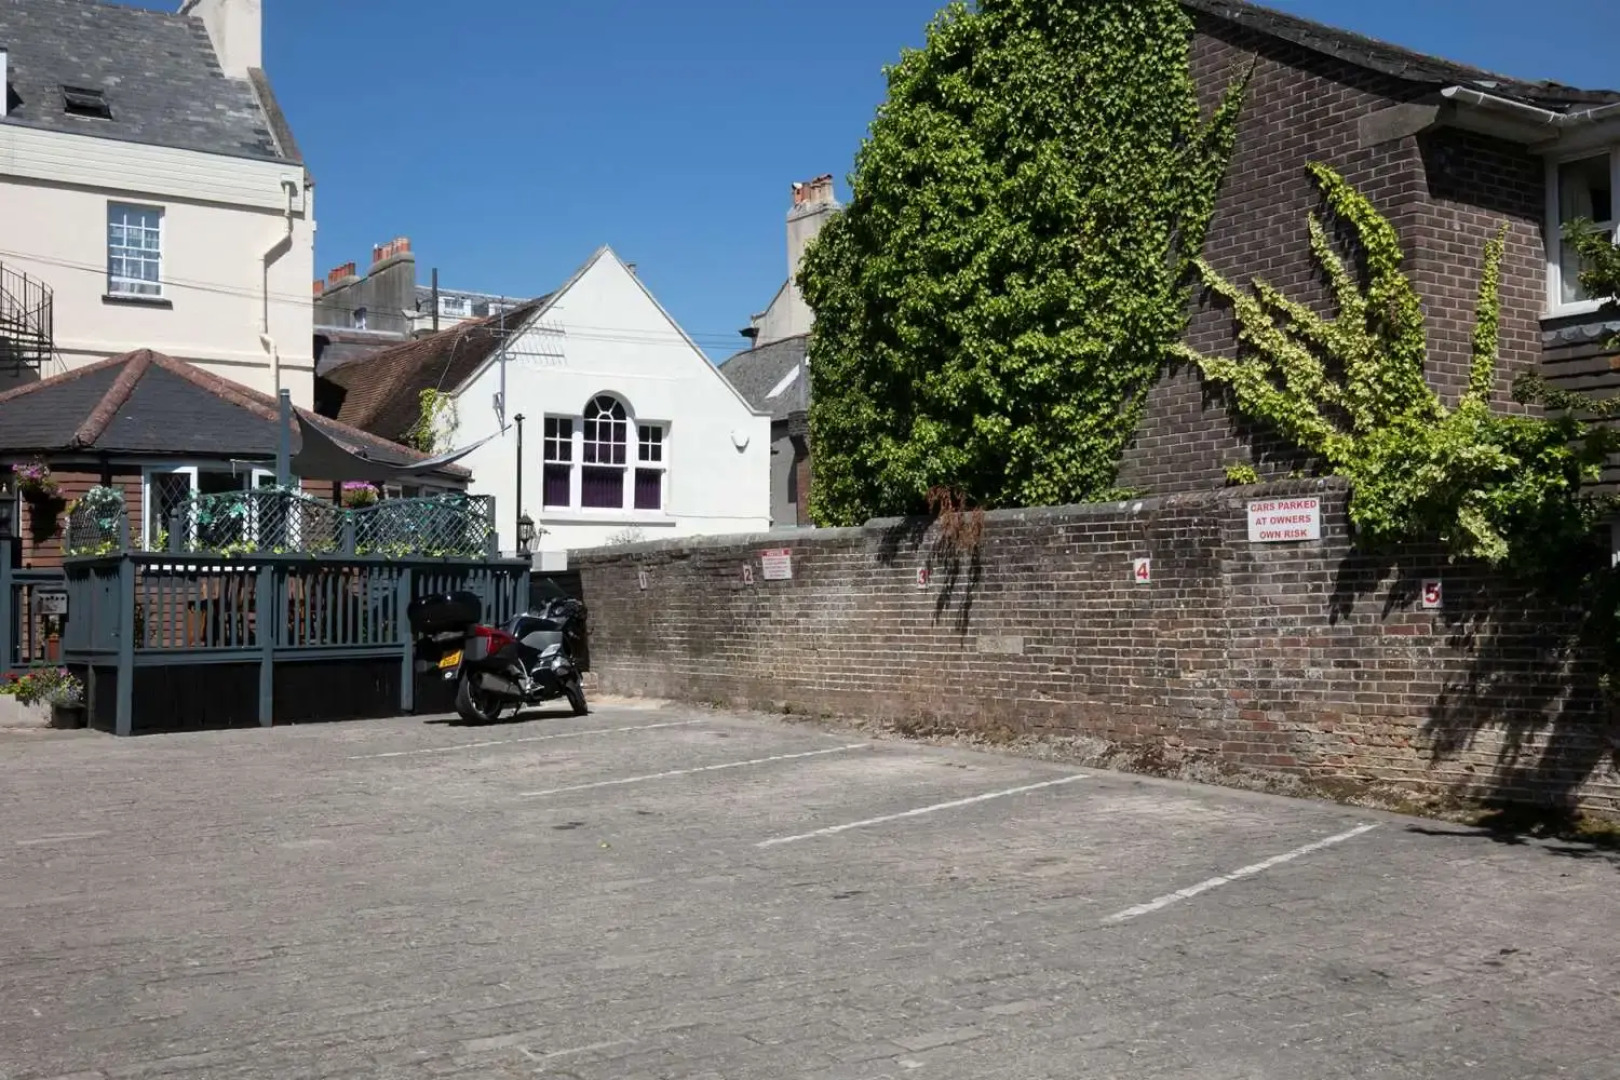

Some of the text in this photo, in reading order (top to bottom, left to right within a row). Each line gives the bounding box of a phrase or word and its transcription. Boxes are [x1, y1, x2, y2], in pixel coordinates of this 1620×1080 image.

[1250, 500, 1317, 512] CARS PARKED
[1256, 515, 1311, 526] AT OWNERS
[1259, 529, 1307, 539] OWN RISK
[918, 569, 927, 585] 3
[1137, 562, 1148, 580] 4
[1425, 582, 1439, 604] 5
